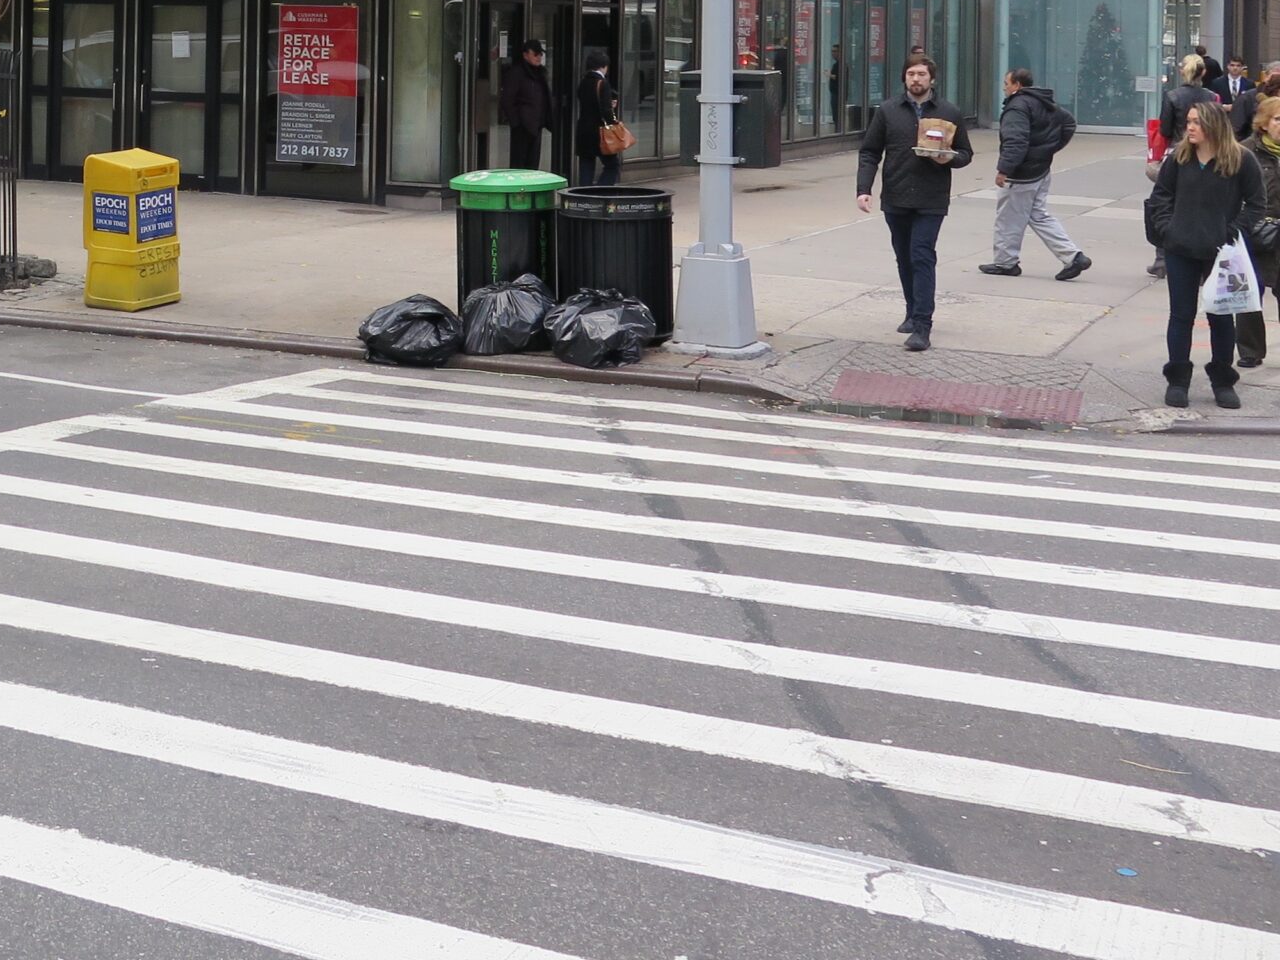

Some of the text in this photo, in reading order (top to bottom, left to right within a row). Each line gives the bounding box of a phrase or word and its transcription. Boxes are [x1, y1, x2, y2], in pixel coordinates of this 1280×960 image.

[283, 34, 335, 47] RETAIL
[283, 47, 330, 60] SPACE
[283, 59, 313, 72] FOR
[283, 71, 329, 85] LEASE
[281, 144, 349, 158] 212 841 7837
[95, 196, 127, 209] EPOCH
[139, 192, 172, 210] EPOCH
[96, 207, 127, 216] WEEKEND
[140, 206, 173, 219] WEEKEND
[140, 221, 173, 233] EPOCH TIMES
[490, 230, 499, 284] MAGAZI
